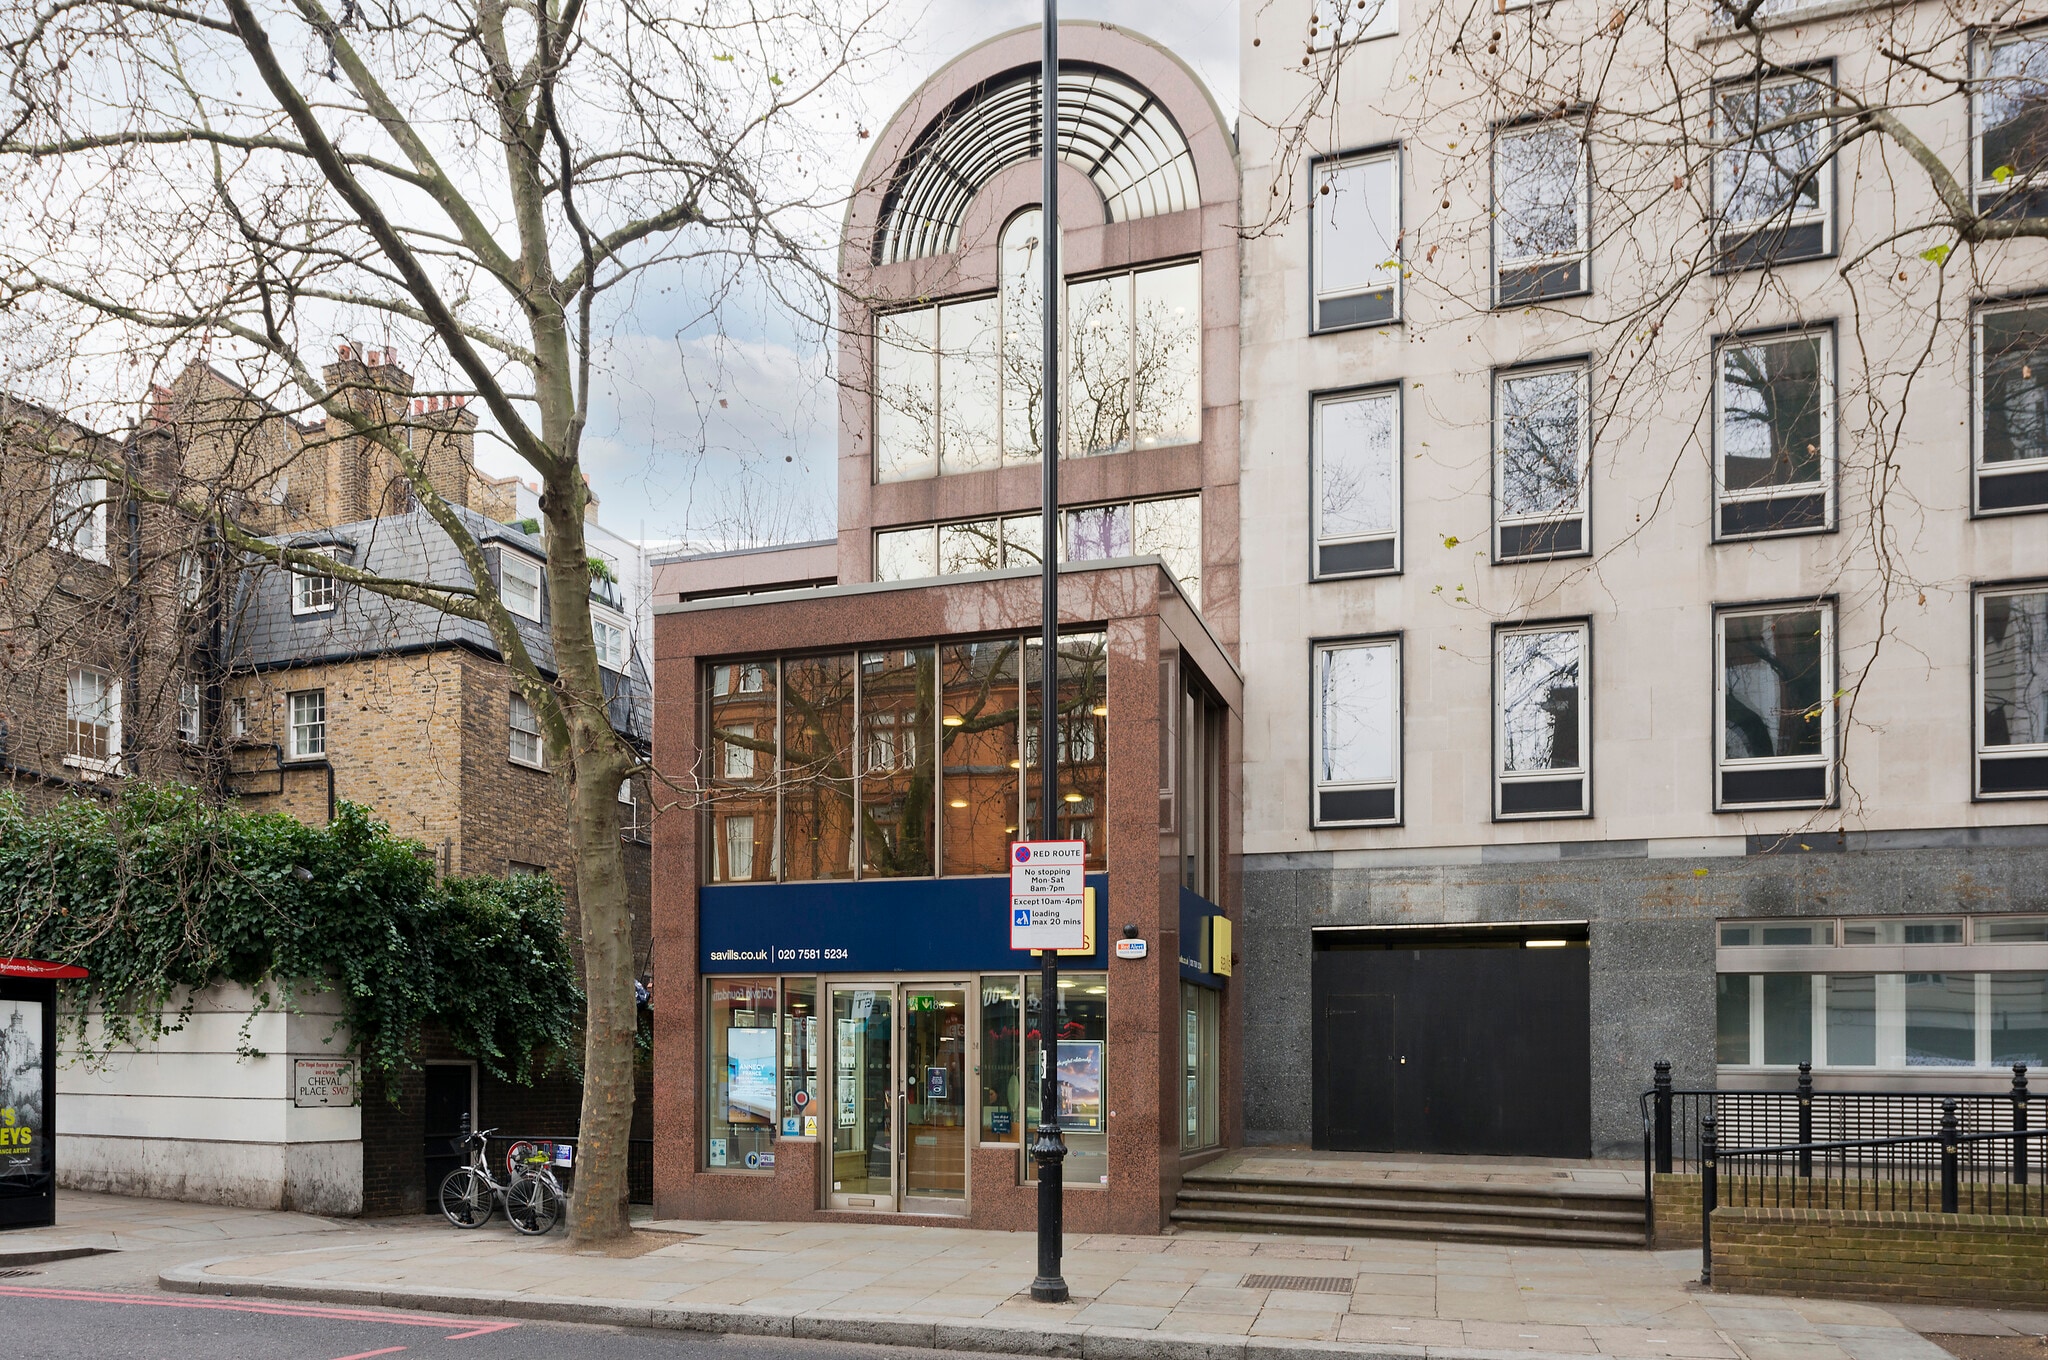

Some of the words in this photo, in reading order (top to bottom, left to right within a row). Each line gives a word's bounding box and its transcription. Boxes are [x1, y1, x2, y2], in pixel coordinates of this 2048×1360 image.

[1033, 850, 1050, 858] RED
[1052, 849, 1081, 857] ROUTE
[1037, 868, 1071, 876] stopping
[1013, 898, 1040, 906] Except
[1032, 910, 1060, 918] loading
[710, 949, 768, 961] savills.co.uk
[778, 949, 795, 960] 020
[798, 949, 821, 960] 7581
[824, 948, 849, 959] 5234
[308, 1077, 342, 1086] CHEVAL
[0, 1127, 32, 1146] EYS
